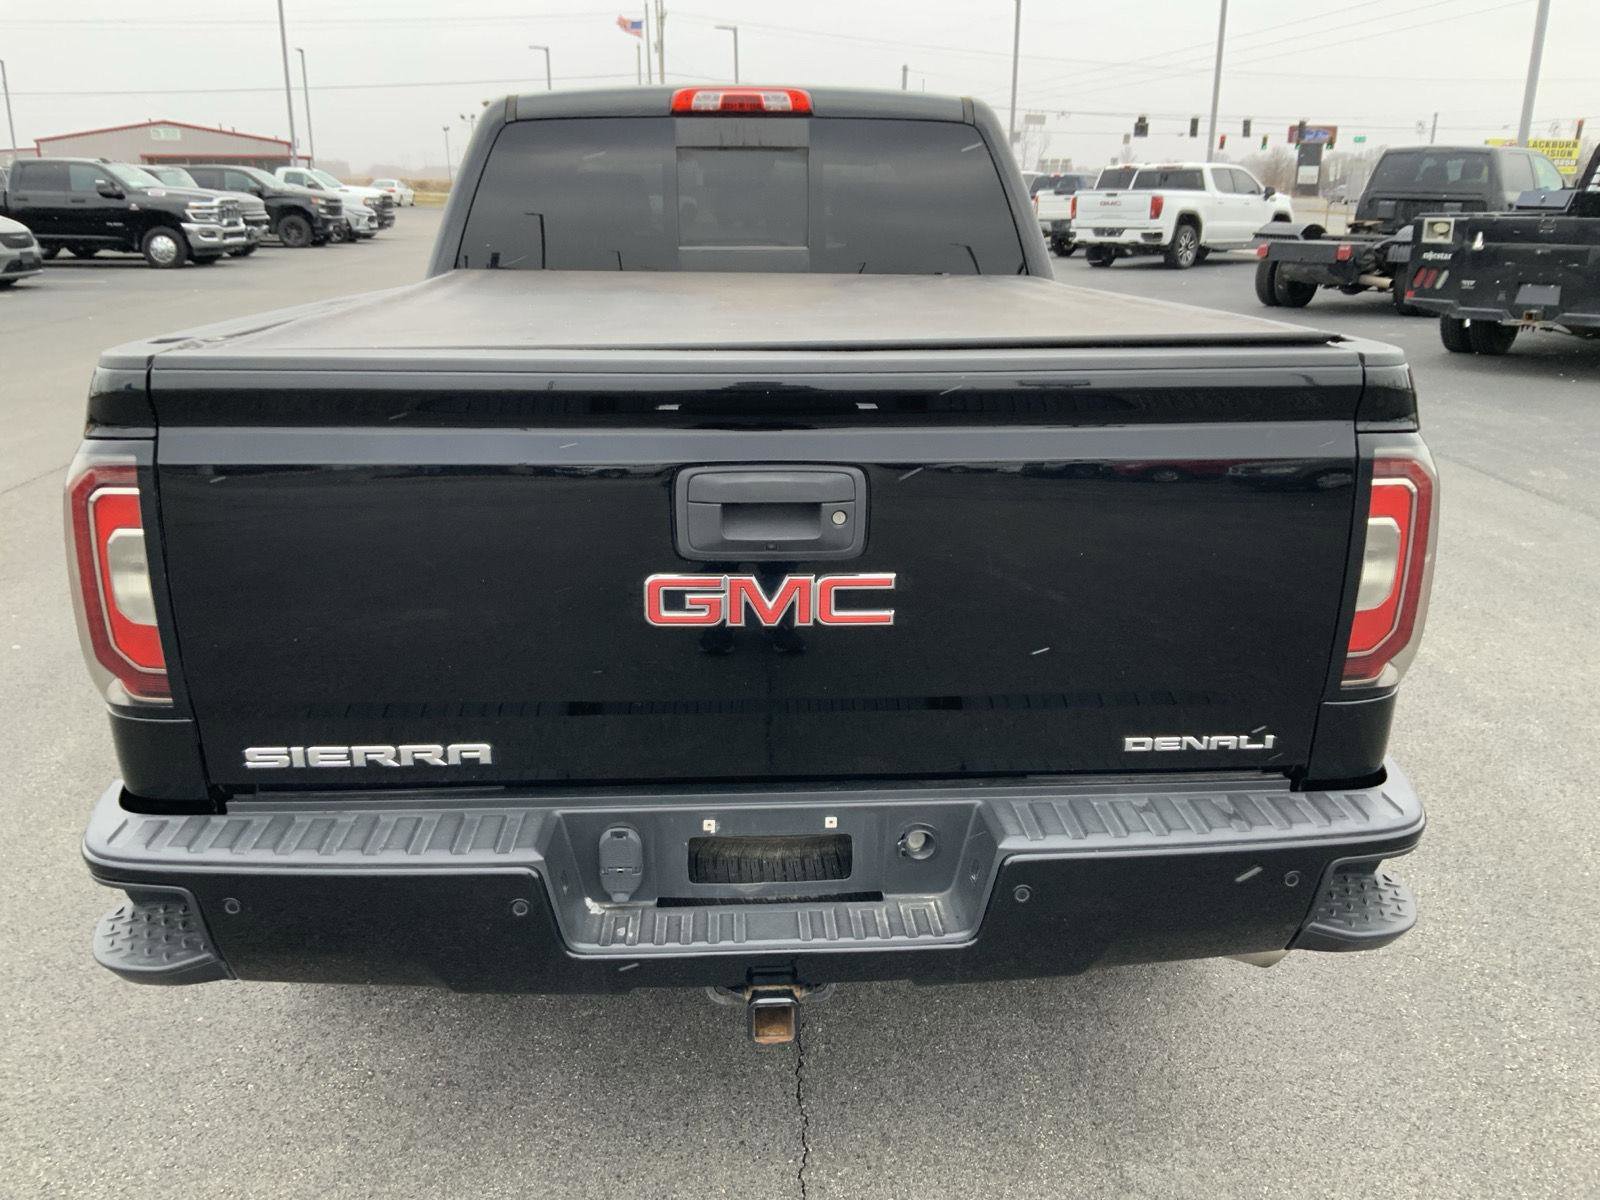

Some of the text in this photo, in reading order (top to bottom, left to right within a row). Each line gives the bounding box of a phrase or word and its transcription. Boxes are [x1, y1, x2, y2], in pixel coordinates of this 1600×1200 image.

[1526, 140, 1578, 149] LACKBURN
[644, 573, 897, 627] GMC
[1124, 735, 1276, 752] DENALI
[244, 743, 492, 768] SIERRA
